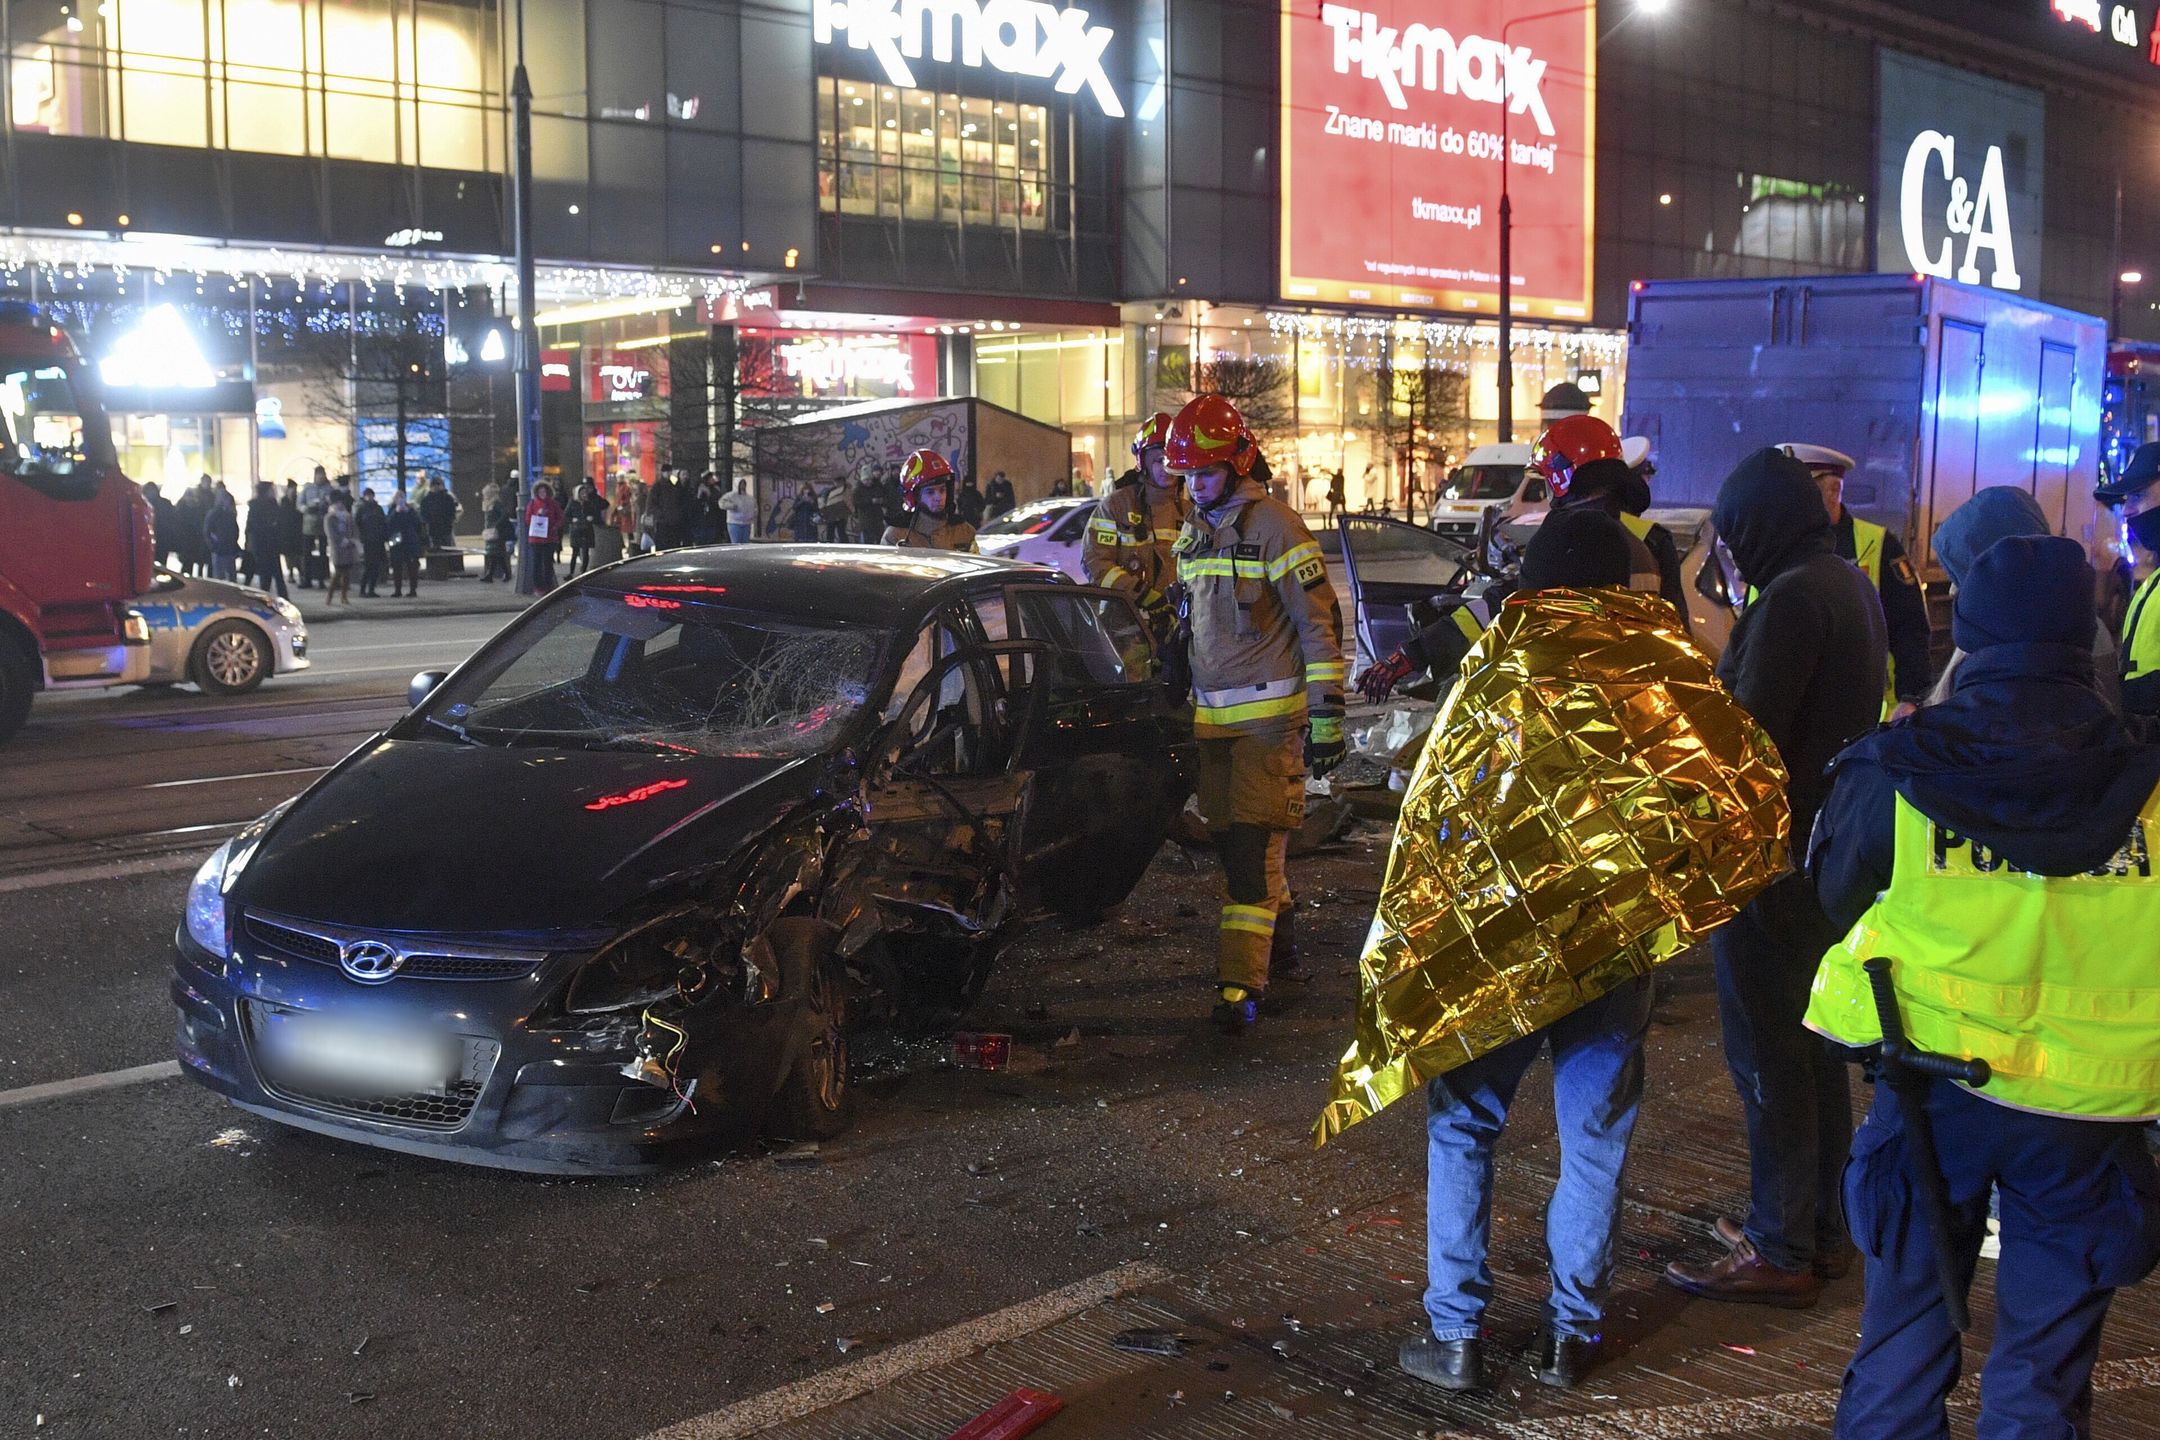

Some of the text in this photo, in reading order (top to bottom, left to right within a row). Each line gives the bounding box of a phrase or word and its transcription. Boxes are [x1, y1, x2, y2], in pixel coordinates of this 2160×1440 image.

[1325, 104, 1384, 142] Znane
[1388, 121, 1436, 150] marki
[1440, 126, 1464, 155] do
[1467, 130, 1505, 161] 60%
[1412, 196, 1481, 230] tkmaxx.pl
[1900, 129, 2021, 291] C&A
[1100, 533, 1115, 543] PSP
[1298, 562, 1318, 580] PSP
